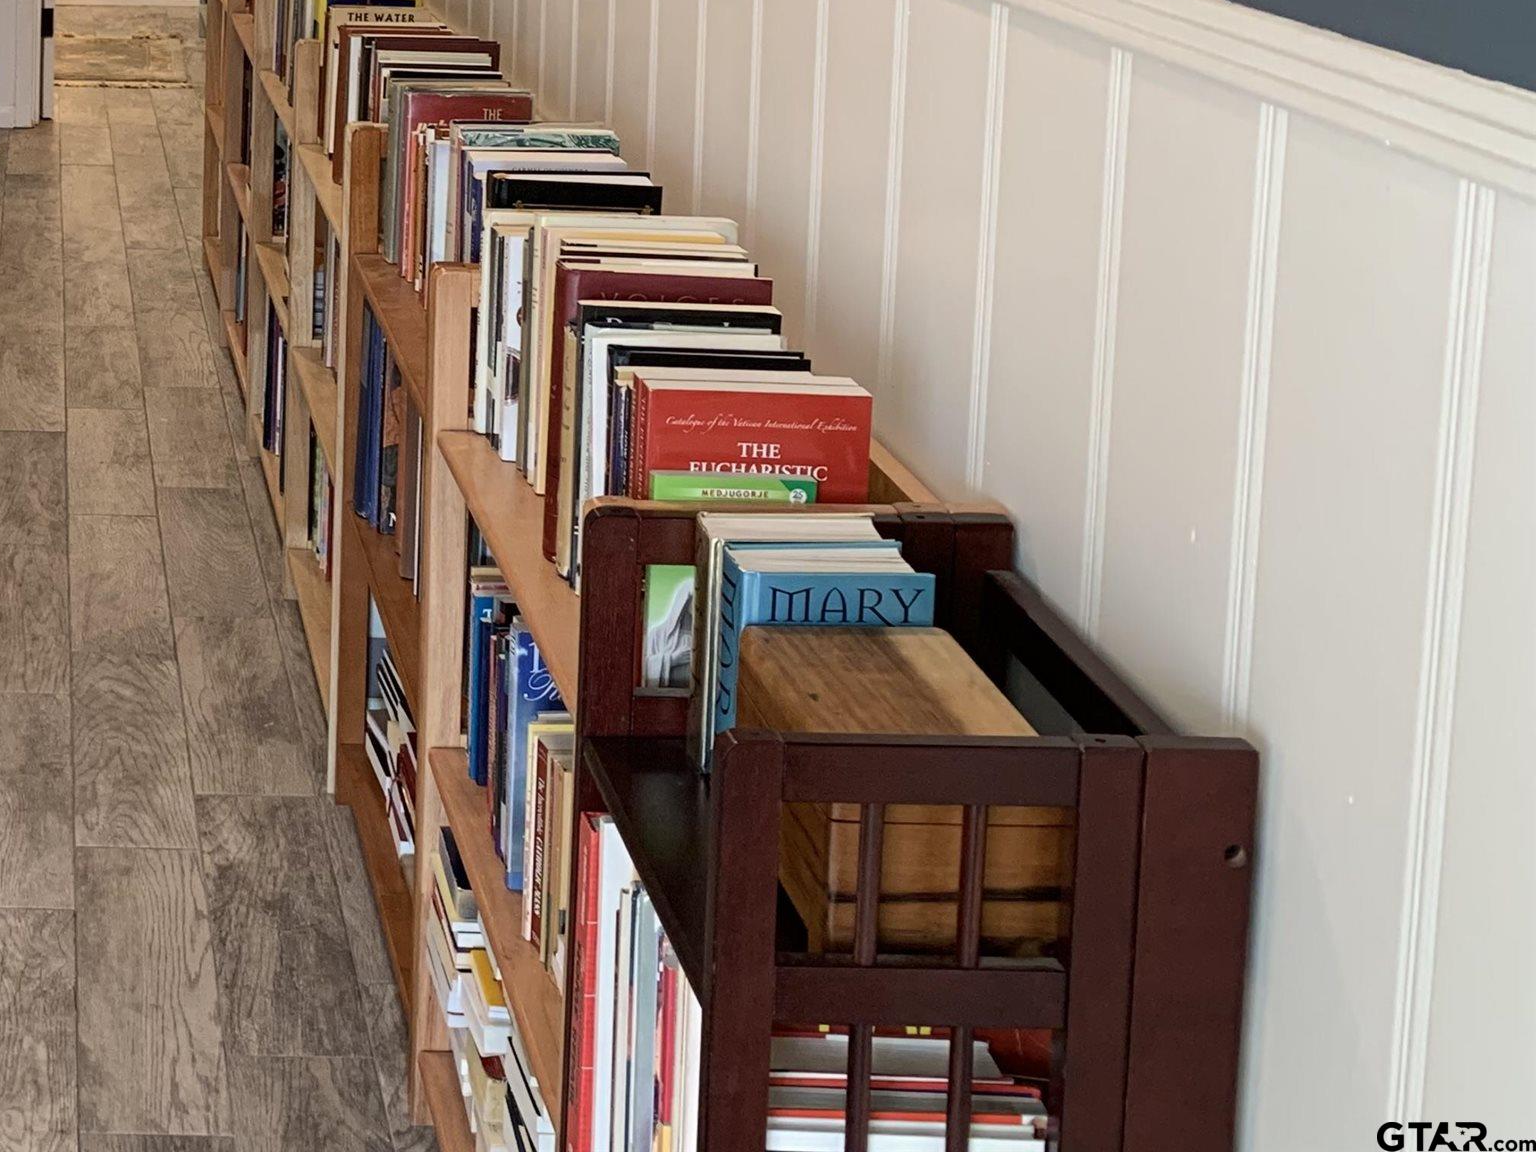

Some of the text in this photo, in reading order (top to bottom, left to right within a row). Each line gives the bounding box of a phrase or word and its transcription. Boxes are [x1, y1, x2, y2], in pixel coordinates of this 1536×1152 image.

[348, 12, 415, 23] THE WATER
[483, 108, 503, 121] THE
[700, 415, 718, 434] of
[737, 442, 781, 459] THE
[689, 461, 828, 482] EUCHARISTIC
[701, 488, 769, 498] MEDJUGORJE
[767, 586, 925, 626] MARY
